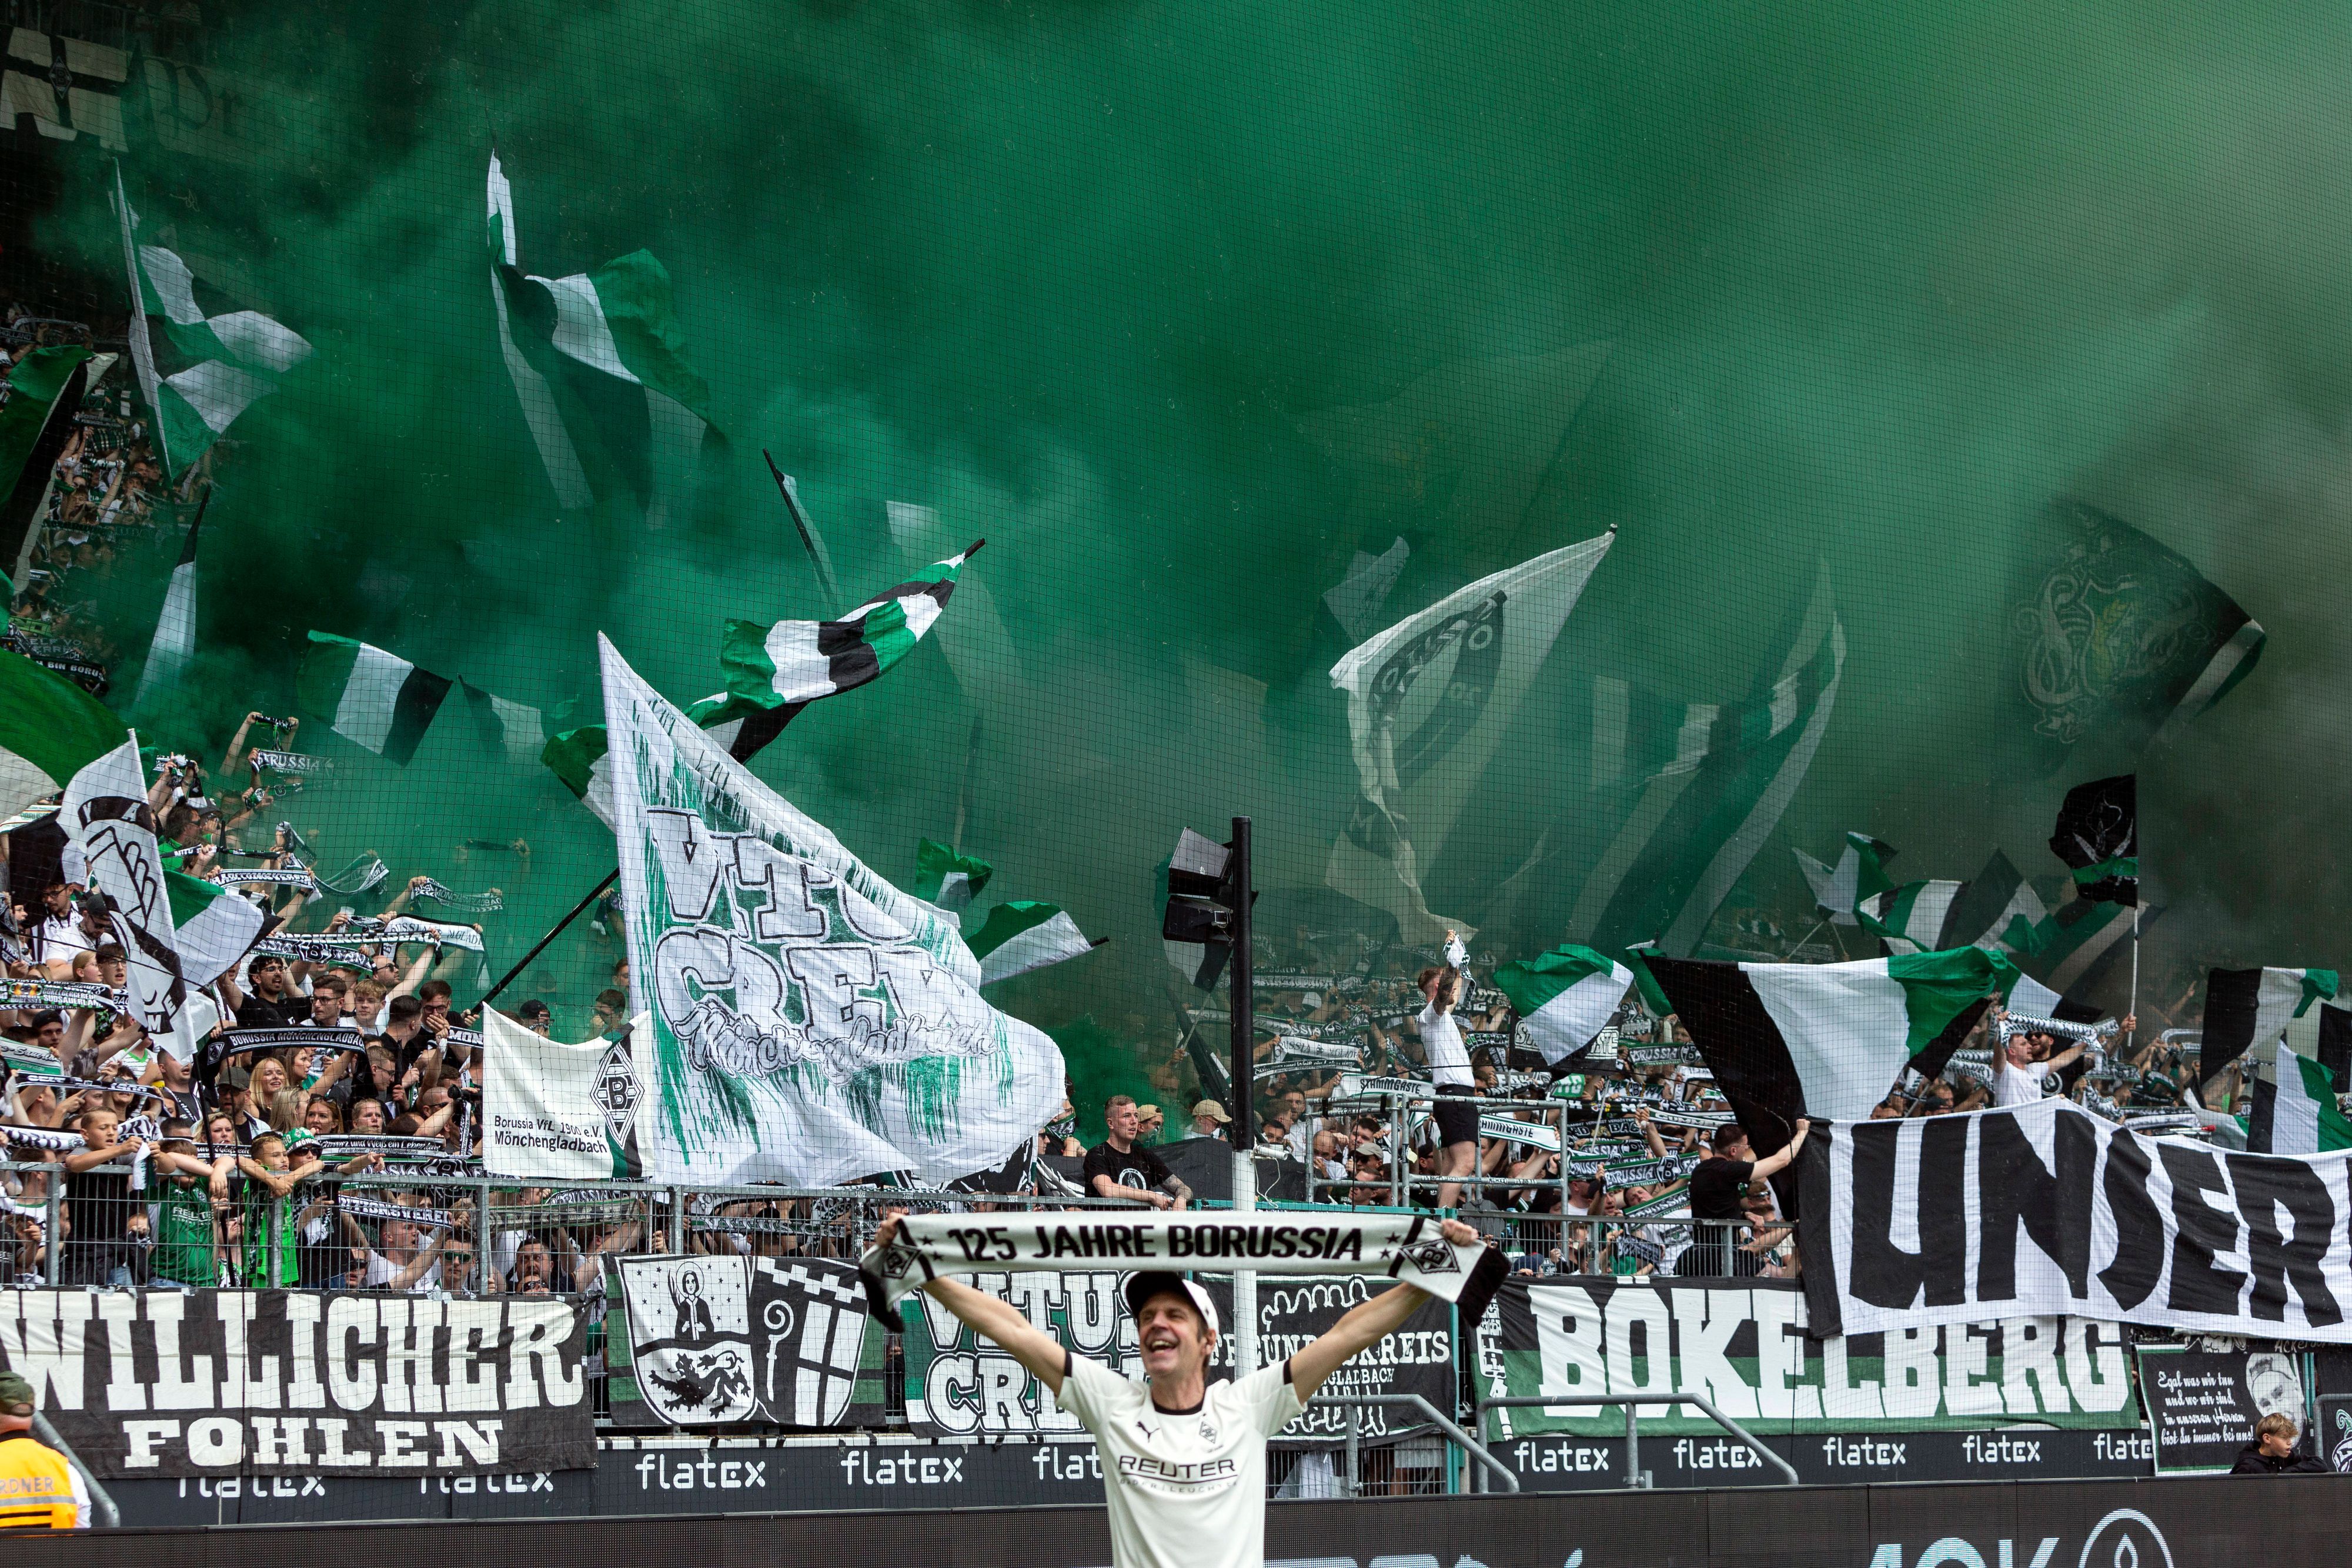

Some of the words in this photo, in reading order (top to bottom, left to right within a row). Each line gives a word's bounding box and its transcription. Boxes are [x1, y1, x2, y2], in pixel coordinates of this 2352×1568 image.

[70, 665, 105, 681] BORUS
[230, 1032, 275, 1047] BORUSSIA
[1359, 1078, 1421, 1094] STAMMGÄSTE
[495, 1115, 533, 1130] Borussia
[537, 1118, 554, 1132] VfL
[560, 1122, 582, 1135] 1900
[584, 1126, 603, 1138] e.V.
[495, 1131, 607, 1153] Mönchengladbach
[1849, 1109, 2351, 1328] UNDER
[947, 1226, 1017, 1262] 125
[1031, 1225, 1157, 1258] JAHRE
[1168, 1223, 1362, 1262] BORUSSIA
[0, 1291, 584, 1412] WILLICHER
[2157, 1370, 2183, 1393] Egal
[2183, 1376, 2201, 1387] was
[2201, 1372, 2217, 1387] wir
[2217, 1375, 2235, 1387] tun
[2165, 1389, 2185, 1407] und
[2185, 1397, 2199, 1406] wo
[2199, 1390, 2215, 1406] wir
[2216, 1388, 2236, 1407] sind,
[2163, 1412, 2175, 1426] in
[2176, 1414, 2212, 1425] unseren
[2212, 1407, 2246, 1426] Herzen
[122, 1416, 504, 1469] FOHLEN
[1962, 1434, 2041, 1463] flatex
[2093, 1432, 2153, 1461] flate
[2161, 1427, 2179, 1446] bist
[2180, 1429, 2191, 1445] du
[2193, 1427, 2222, 1445] immer
[2223, 1425, 2235, 1442] bei
[2236, 1425, 2254, 1442] uns!
[1032, 1446, 1104, 1480] flat
[1514, 1440, 1610, 1474] flatex
[1823, 1436, 1906, 1467] flatex
[635, 1453, 767, 1491] flatex
[841, 1449, 964, 1486] flatex
[1119, 1455, 1236, 1479] REUTER
